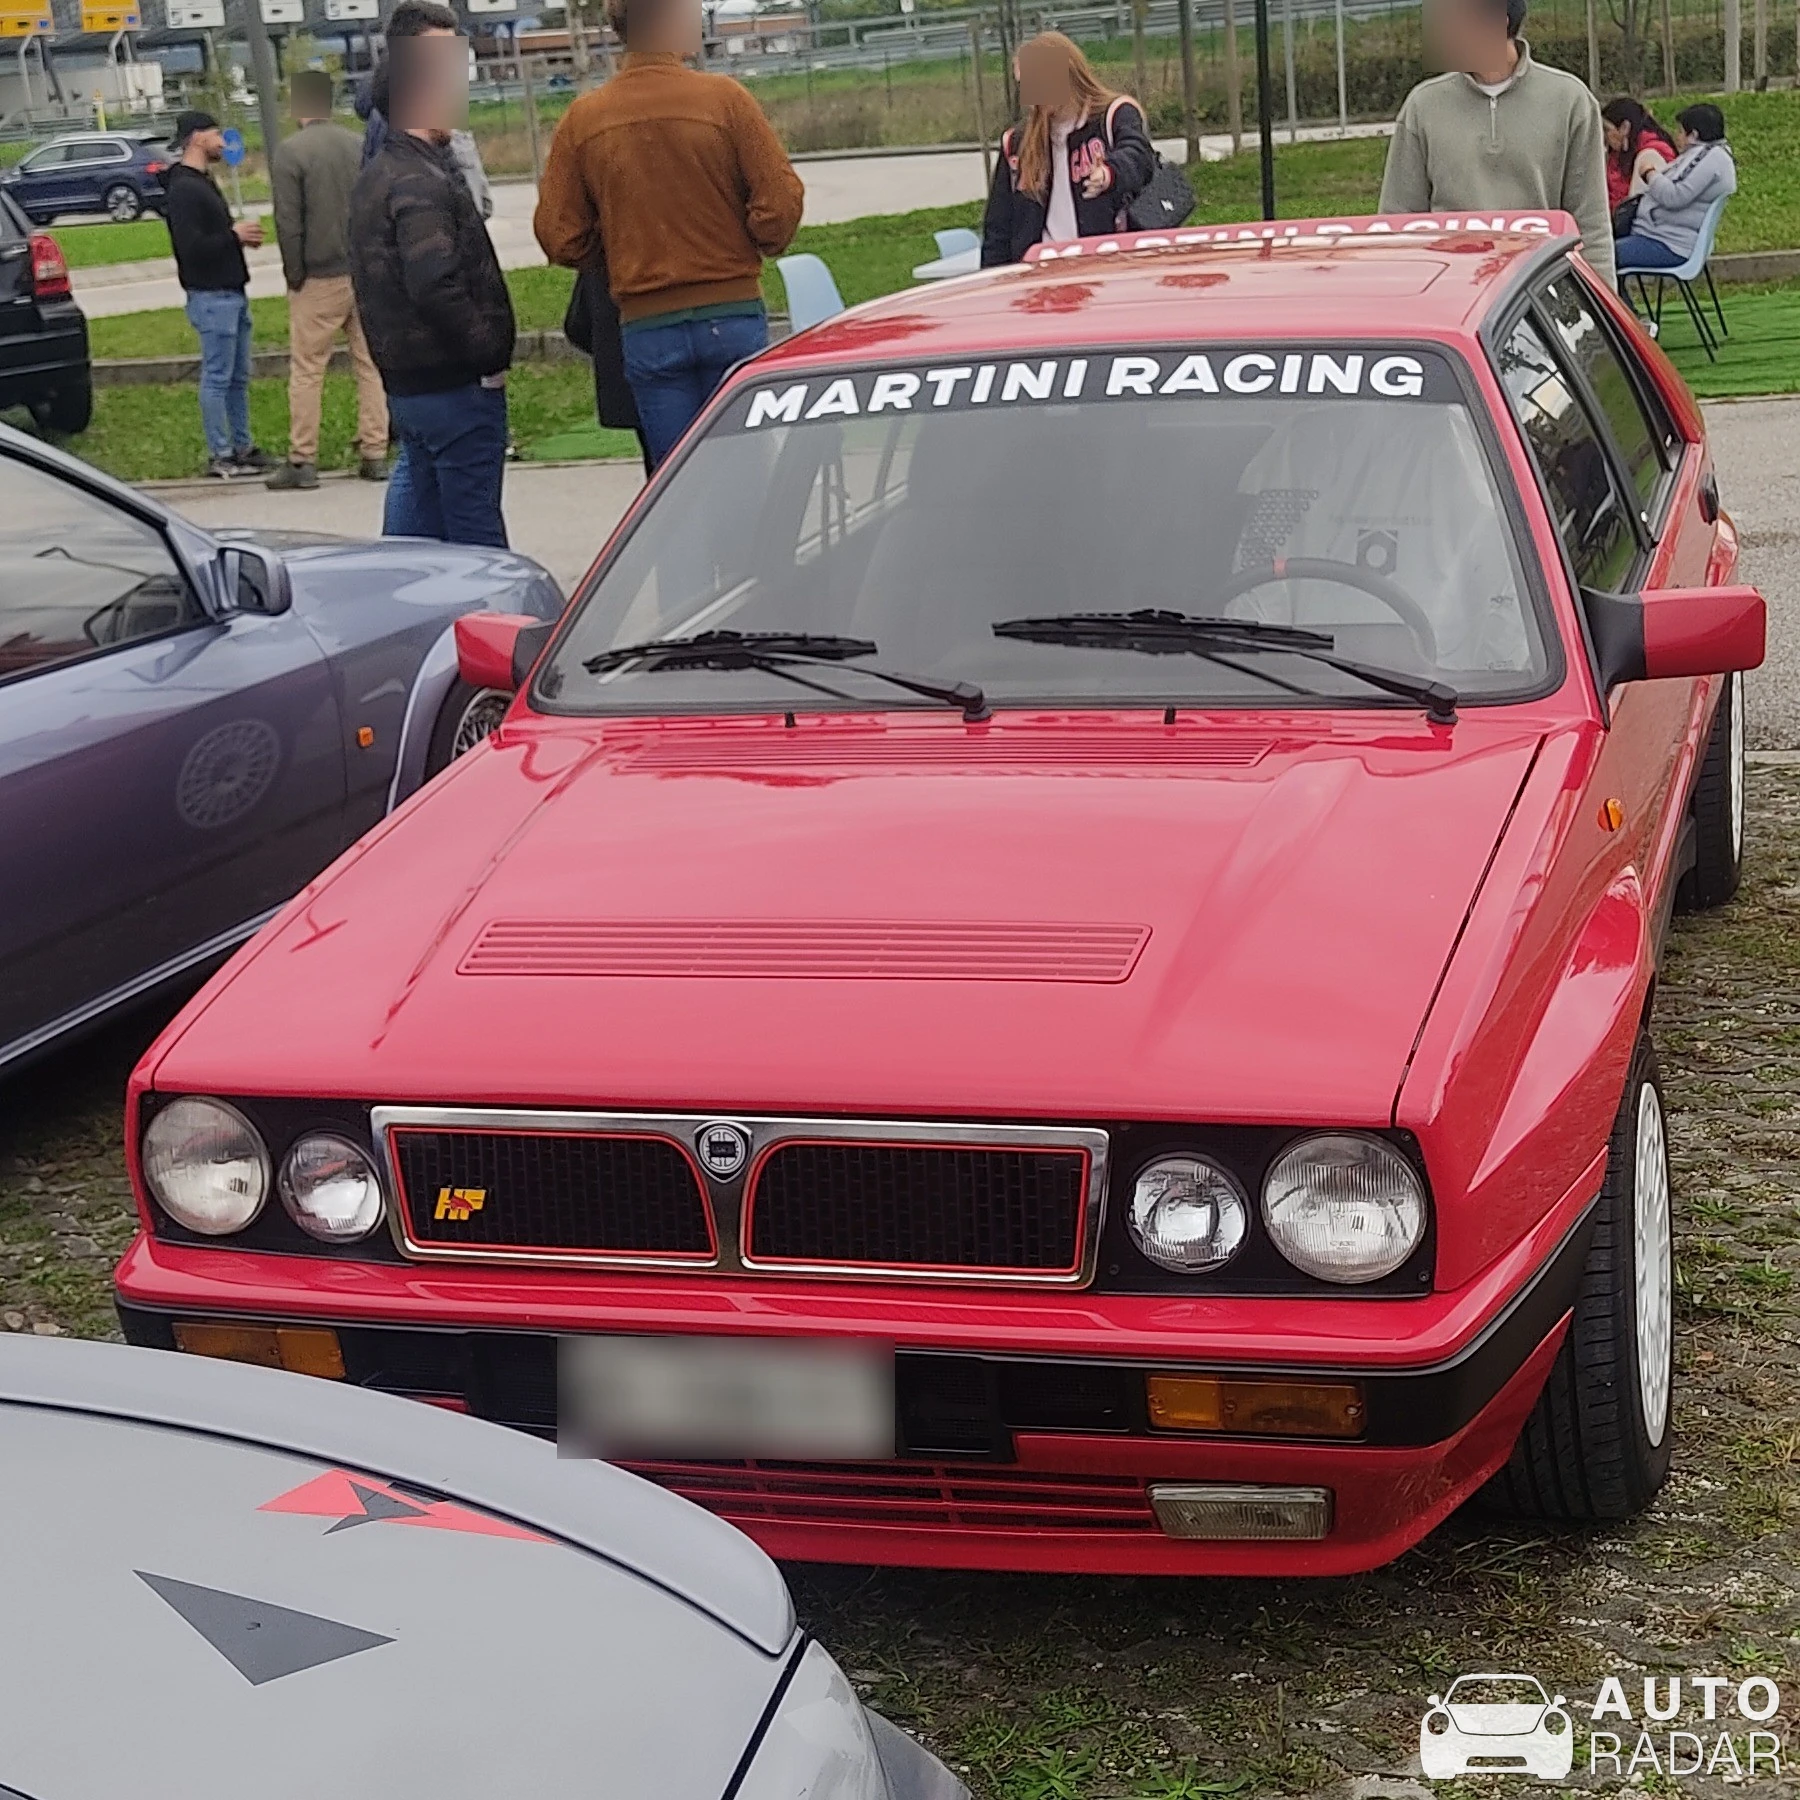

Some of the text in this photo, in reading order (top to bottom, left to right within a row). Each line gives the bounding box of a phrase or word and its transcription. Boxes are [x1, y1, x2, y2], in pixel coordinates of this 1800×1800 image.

[744, 354, 1424, 428] MARTINI RACING
[434, 1187, 486, 1220] HF
